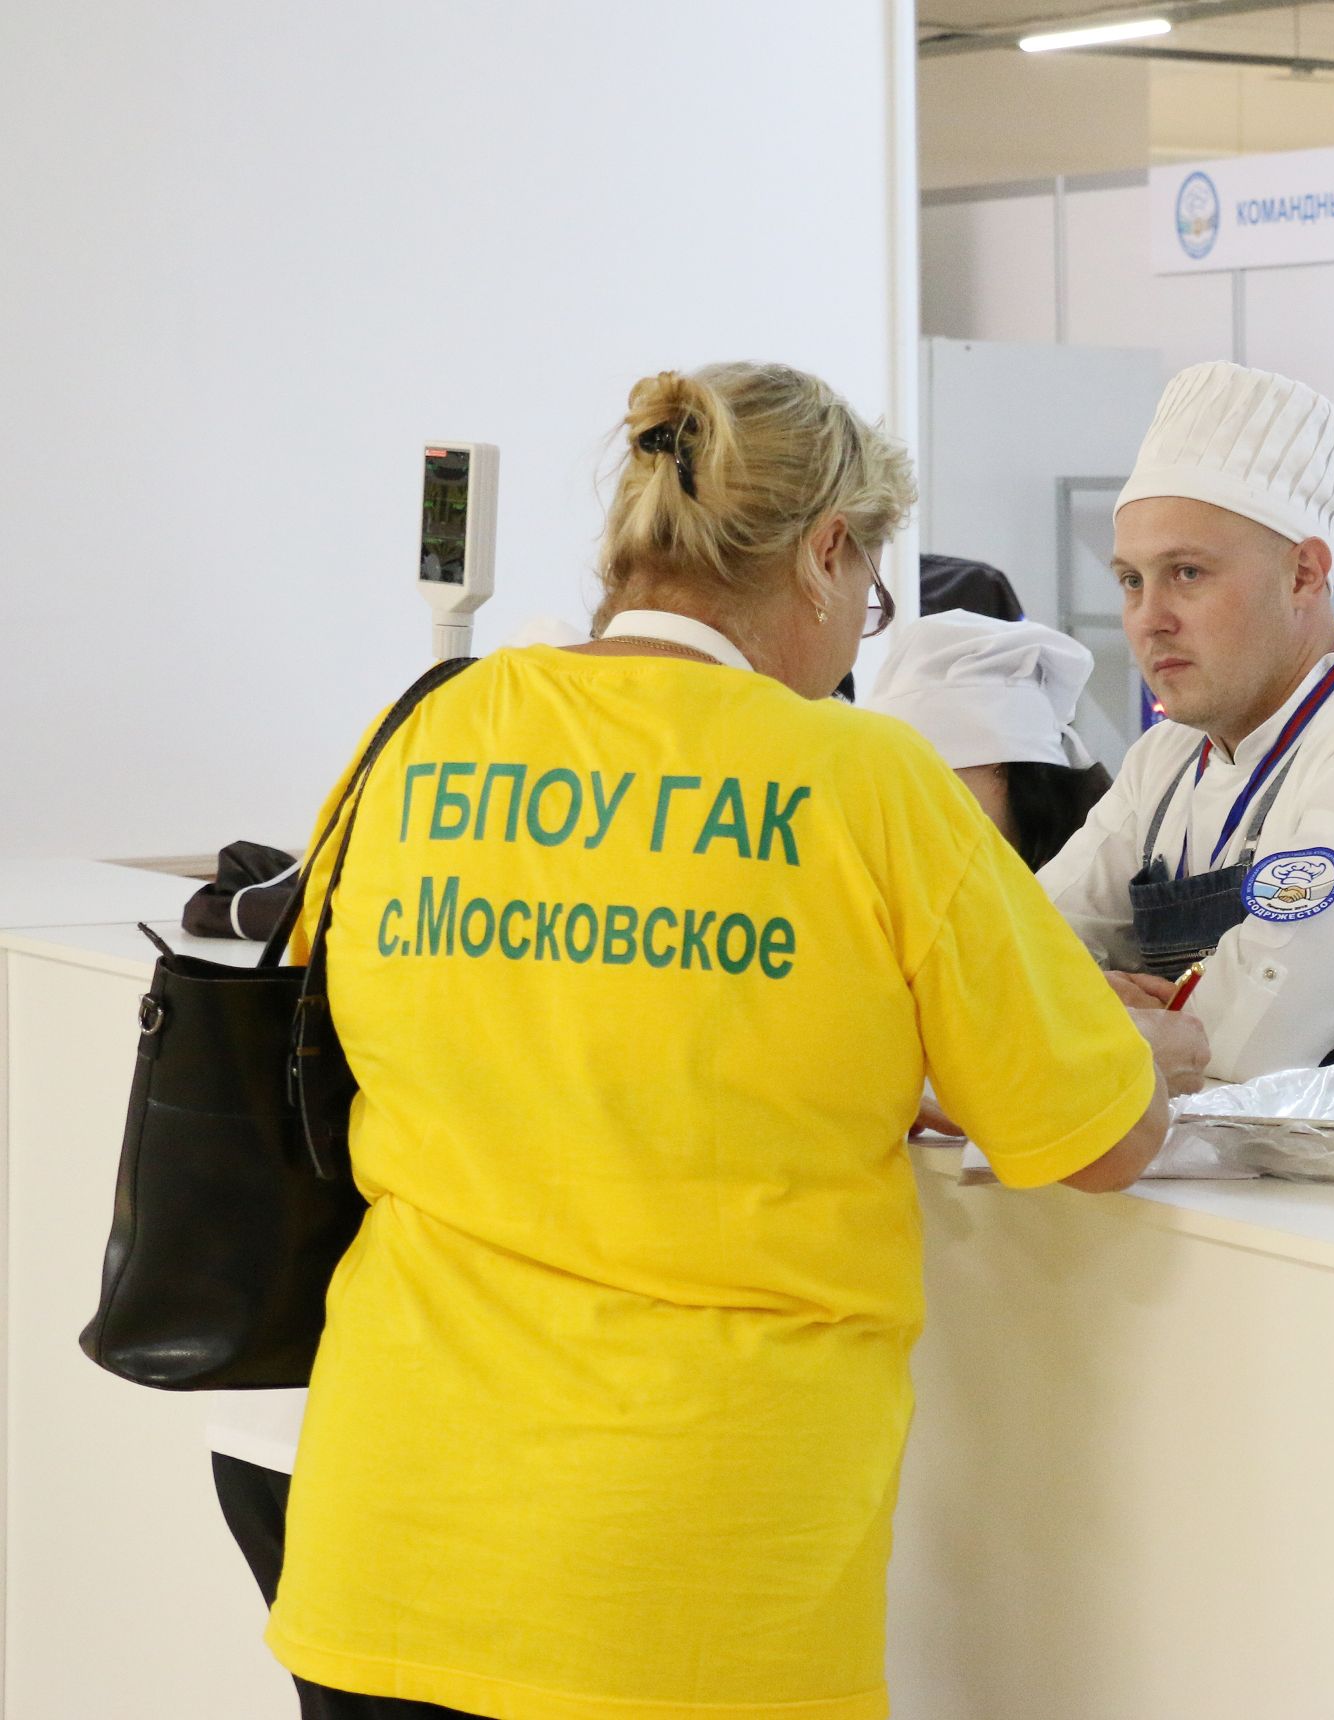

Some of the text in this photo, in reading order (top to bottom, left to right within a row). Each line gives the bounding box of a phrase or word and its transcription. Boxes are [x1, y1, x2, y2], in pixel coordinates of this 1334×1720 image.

[399, 762, 812, 867] ГБПОУ ГАК
[377, 875, 798, 980] с.Московское
